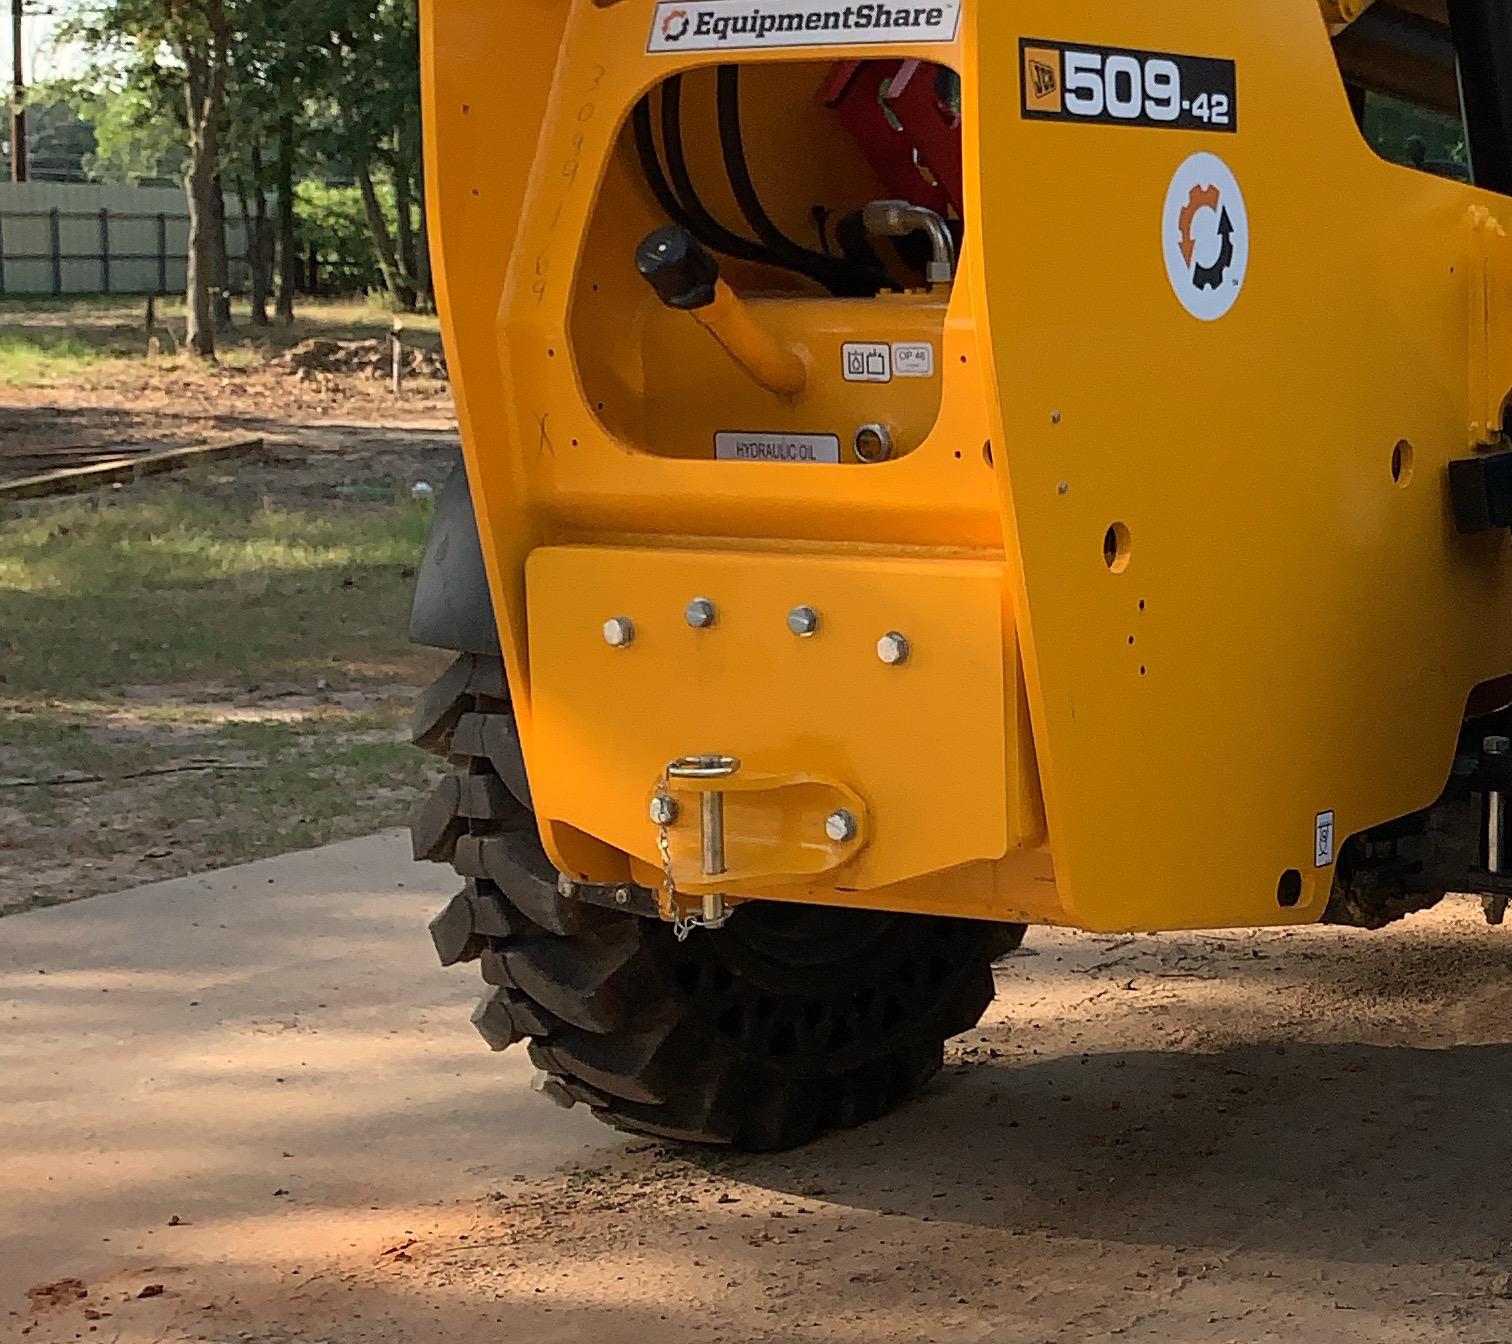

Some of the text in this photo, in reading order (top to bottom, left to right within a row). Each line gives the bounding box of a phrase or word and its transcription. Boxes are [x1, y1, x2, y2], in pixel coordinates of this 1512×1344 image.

[693, 3, 943, 41] EquipmentShare
[736, 441, 817, 461] HYDRAULIC OIL
